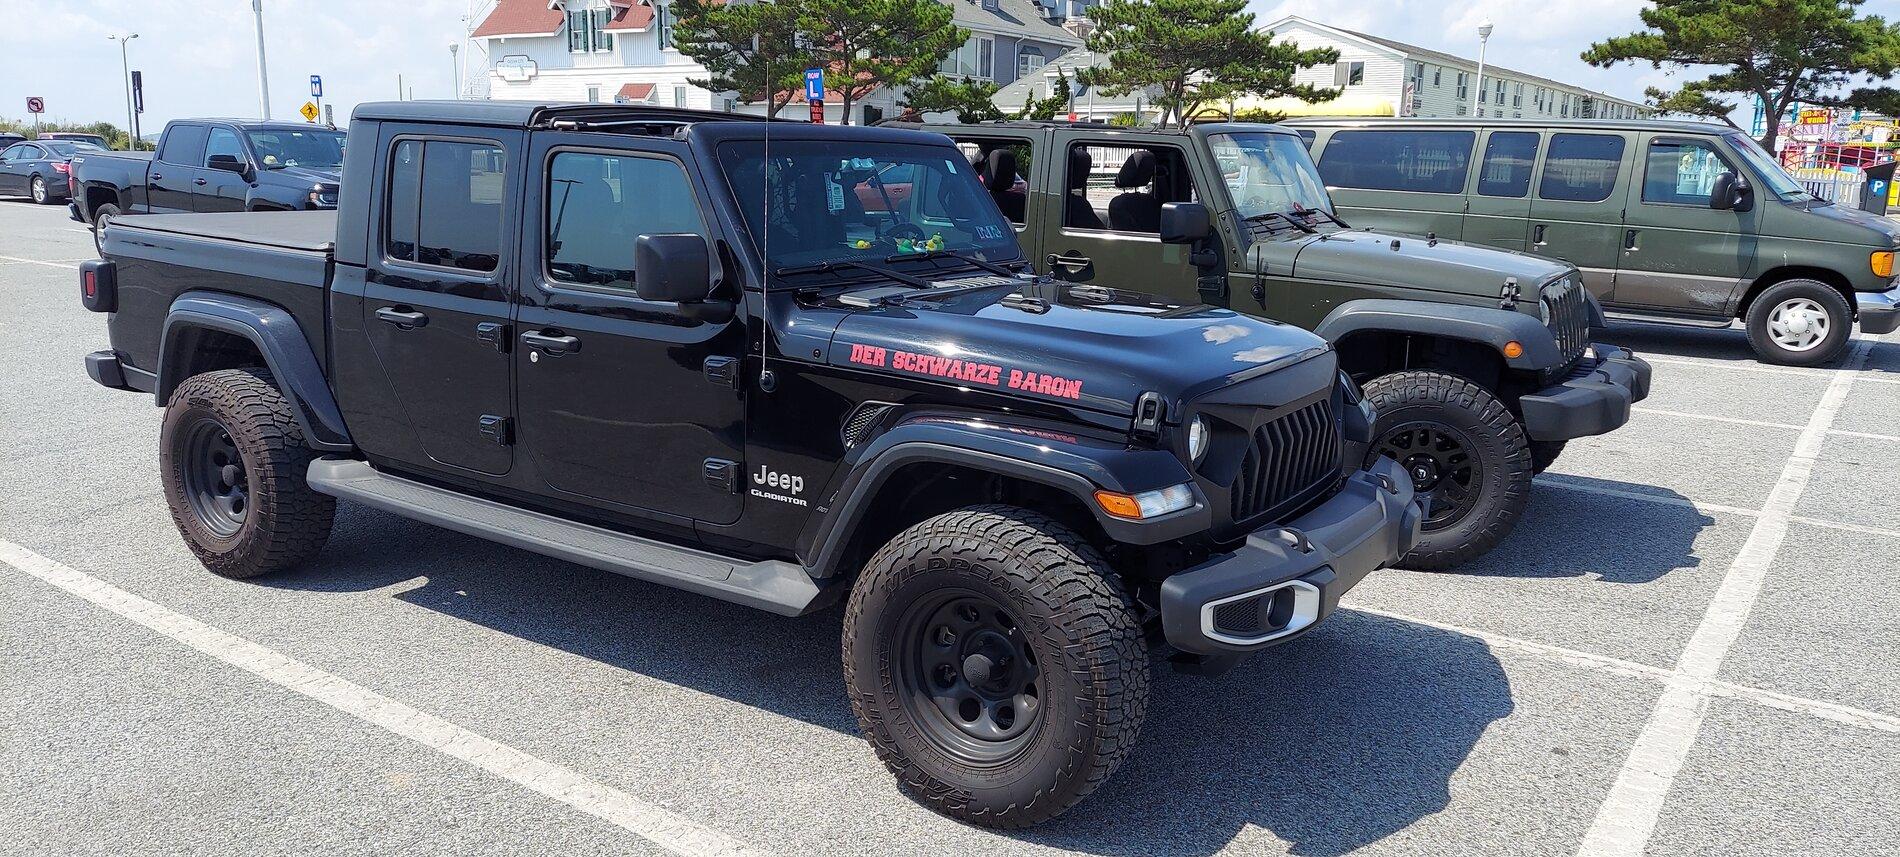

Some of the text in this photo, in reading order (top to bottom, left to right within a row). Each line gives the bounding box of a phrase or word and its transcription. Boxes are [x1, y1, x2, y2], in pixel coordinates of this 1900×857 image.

[810, 80, 819, 97] L
[1873, 180, 1884, 192] P
[850, 344, 1083, 400] DER SCHWARZE BARON
[753, 465, 804, 495] Jeep
[751, 488, 807, 507] GLADIATOR
[882, 557, 1034, 609] WILDPEAK
